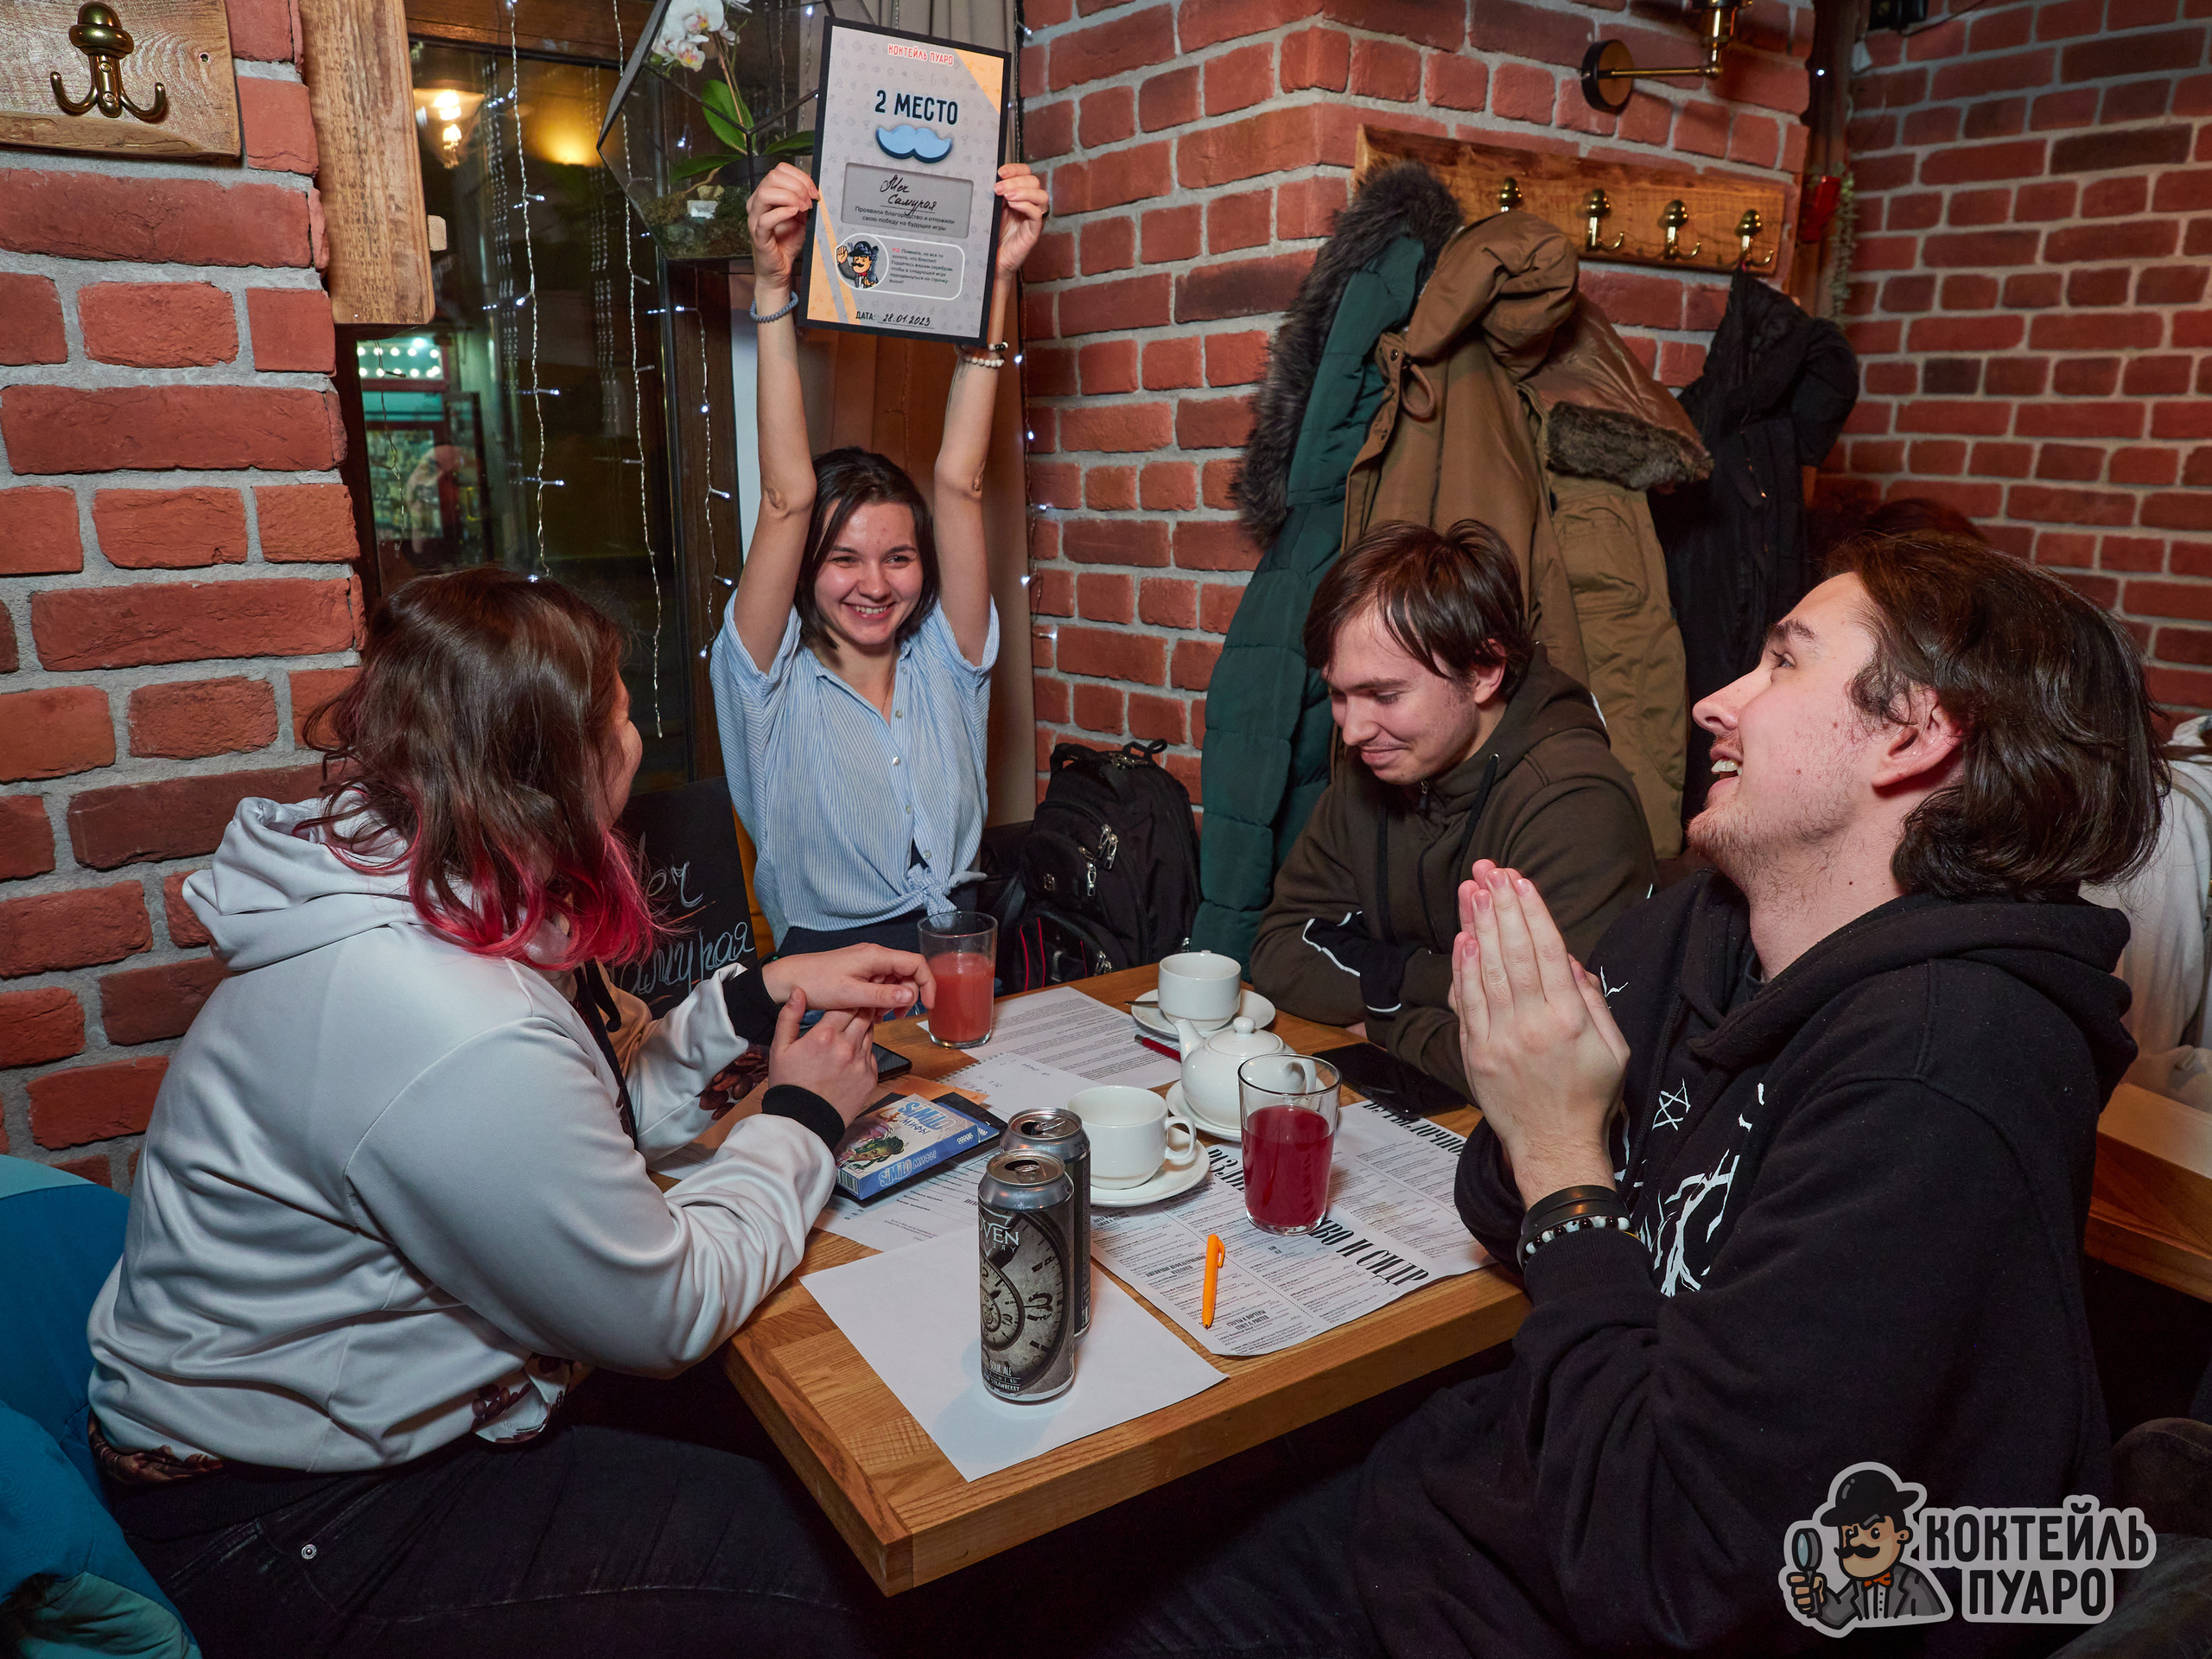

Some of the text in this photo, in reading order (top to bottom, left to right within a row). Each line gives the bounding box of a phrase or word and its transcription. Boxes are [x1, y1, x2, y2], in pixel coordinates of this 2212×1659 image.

[887, 44, 954, 66] КОКТЕЙЛЬ ПУАРО
[874, 89, 959, 126] 2 МЕСТО
[855, 206, 884, 216] Проявили
[887, 194, 938, 216] Самурая
[855, 311, 876, 321] ДАТА:
[882, 313, 931, 327] 28.01.2023
[620, 921, 755, 995] амурая
[1356, 1249, 1430, 1287] СИДР
[1002, 1366, 1012, 1376] ALE
[990, 1377, 1020, 1392] STRAWBERRY
